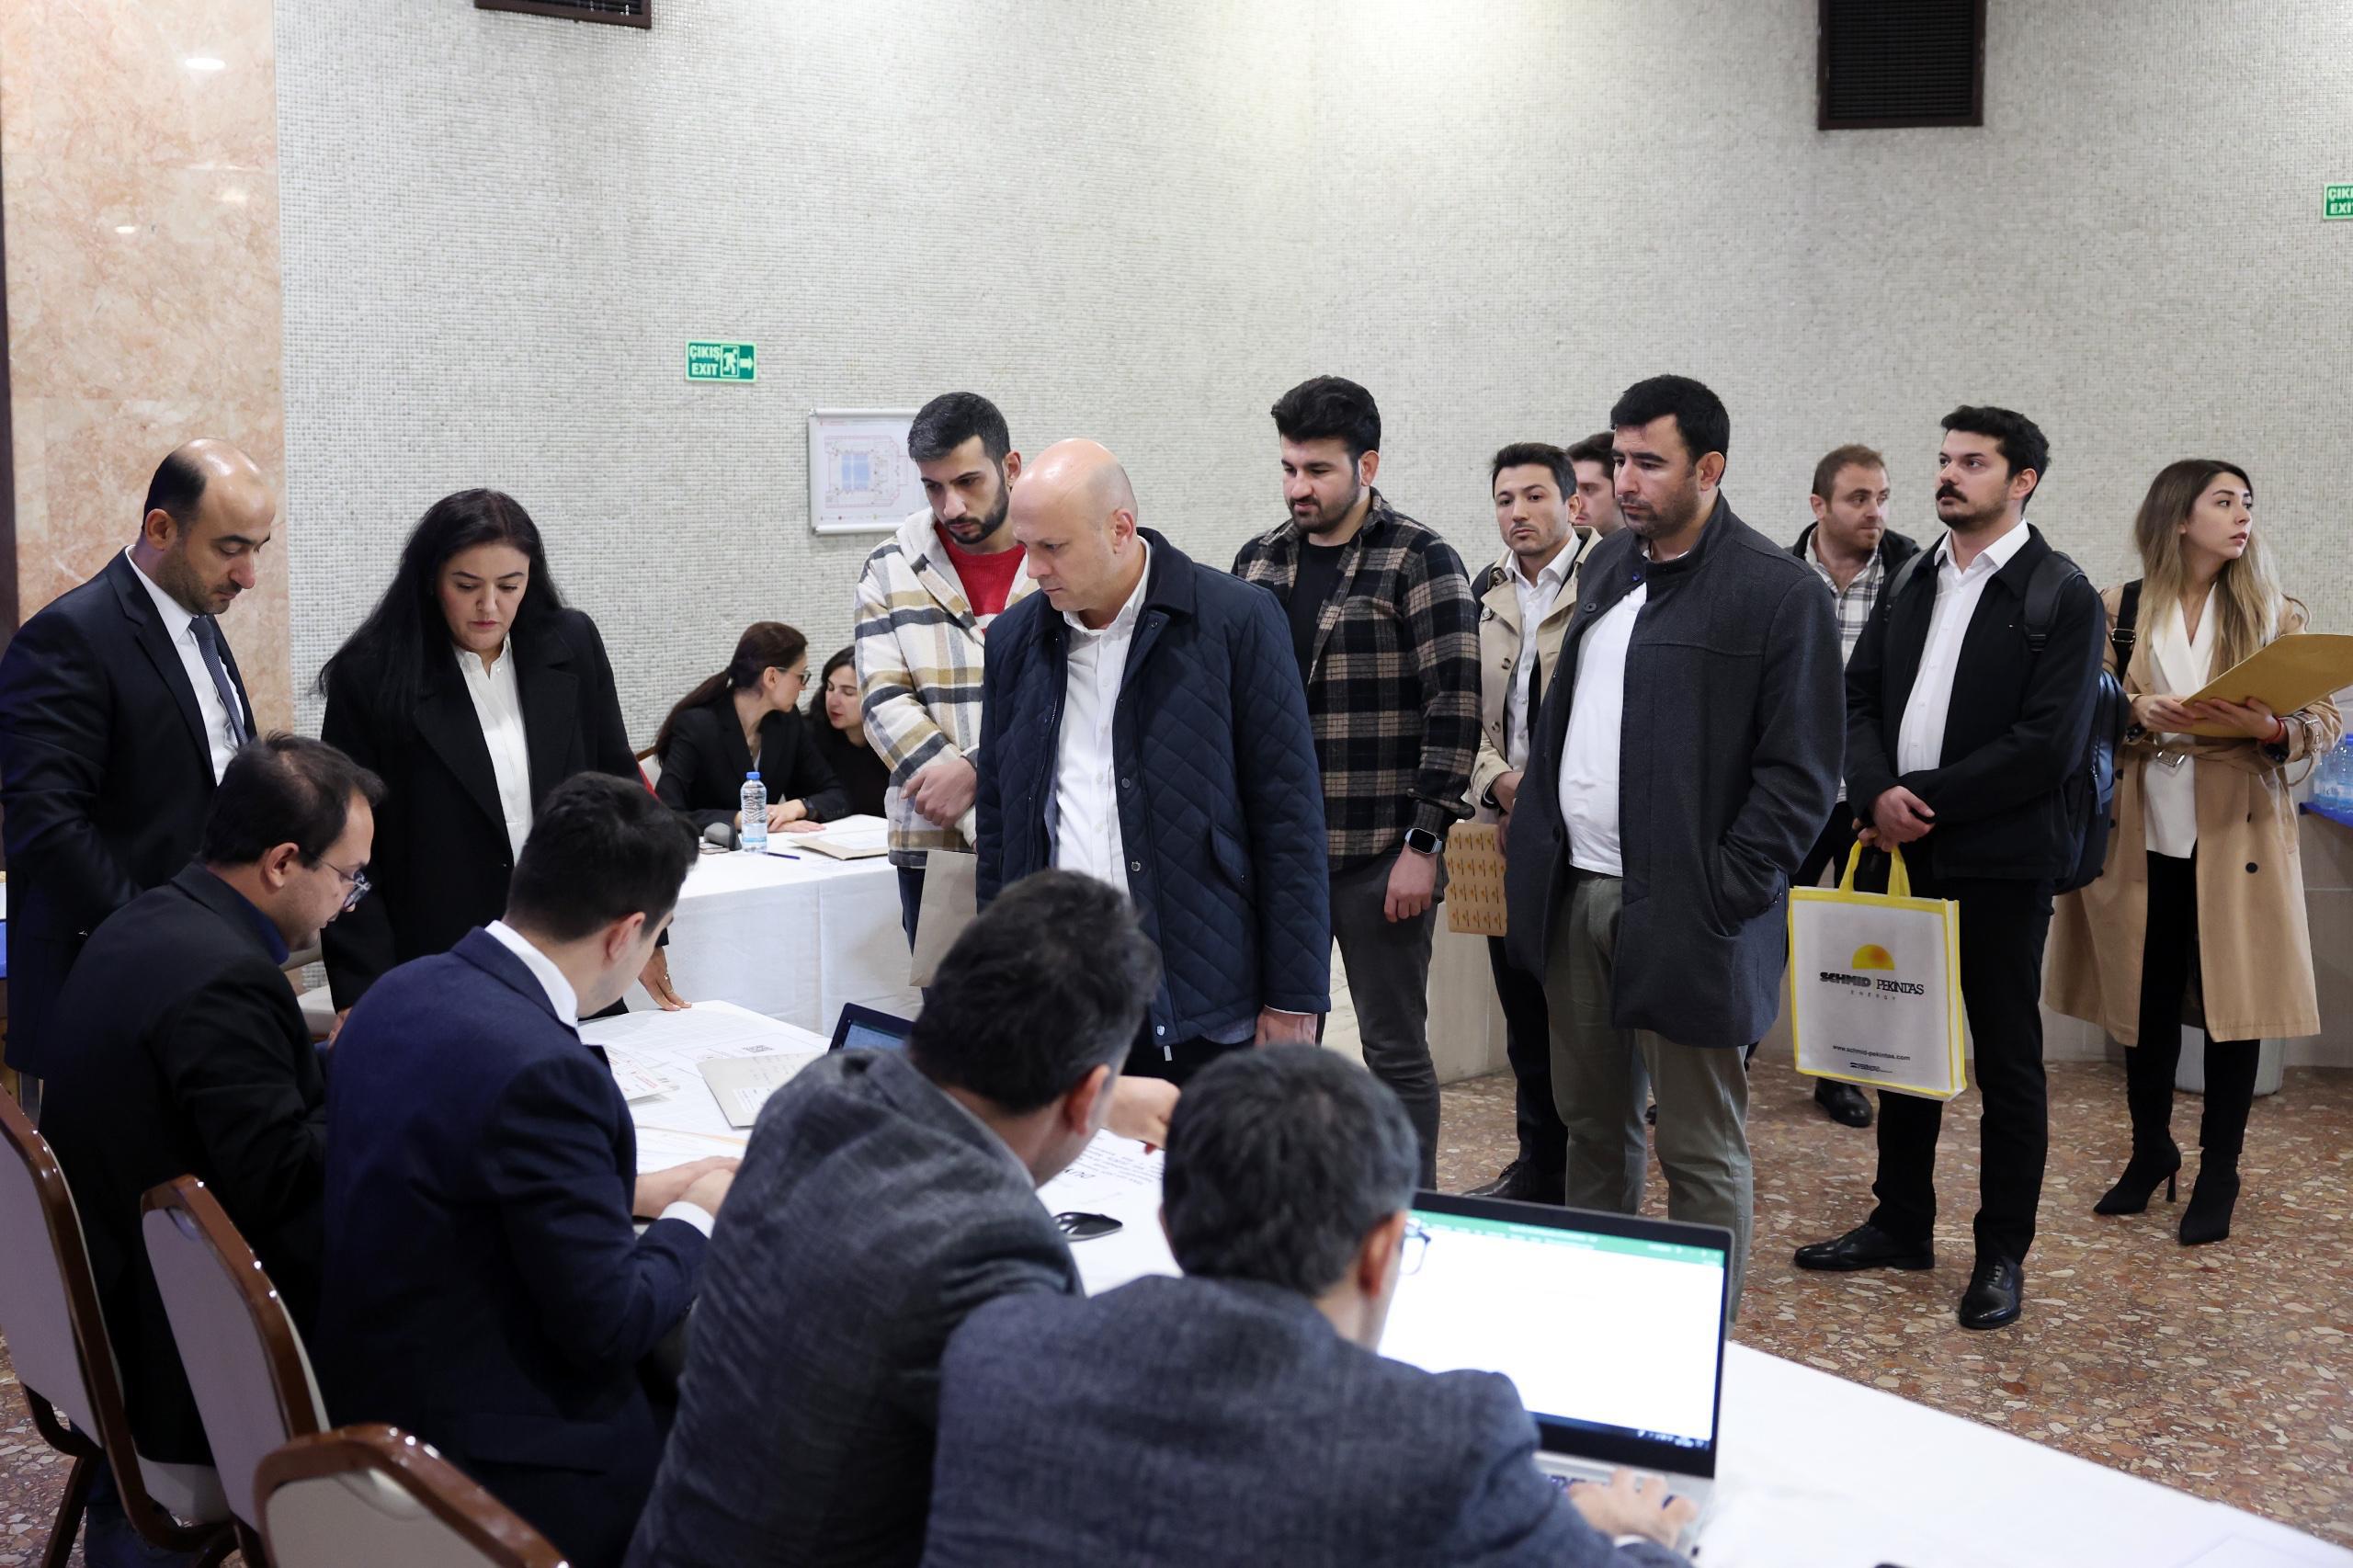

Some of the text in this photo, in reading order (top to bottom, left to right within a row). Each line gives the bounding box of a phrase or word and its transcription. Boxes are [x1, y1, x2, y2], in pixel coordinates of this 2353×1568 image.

[2330, 202, 2353, 214] EXI
[689, 345, 721, 361] ÇIKIŞ
[691, 363, 718, 376] EXIT
[1820, 971, 1871, 987] SCHMID
